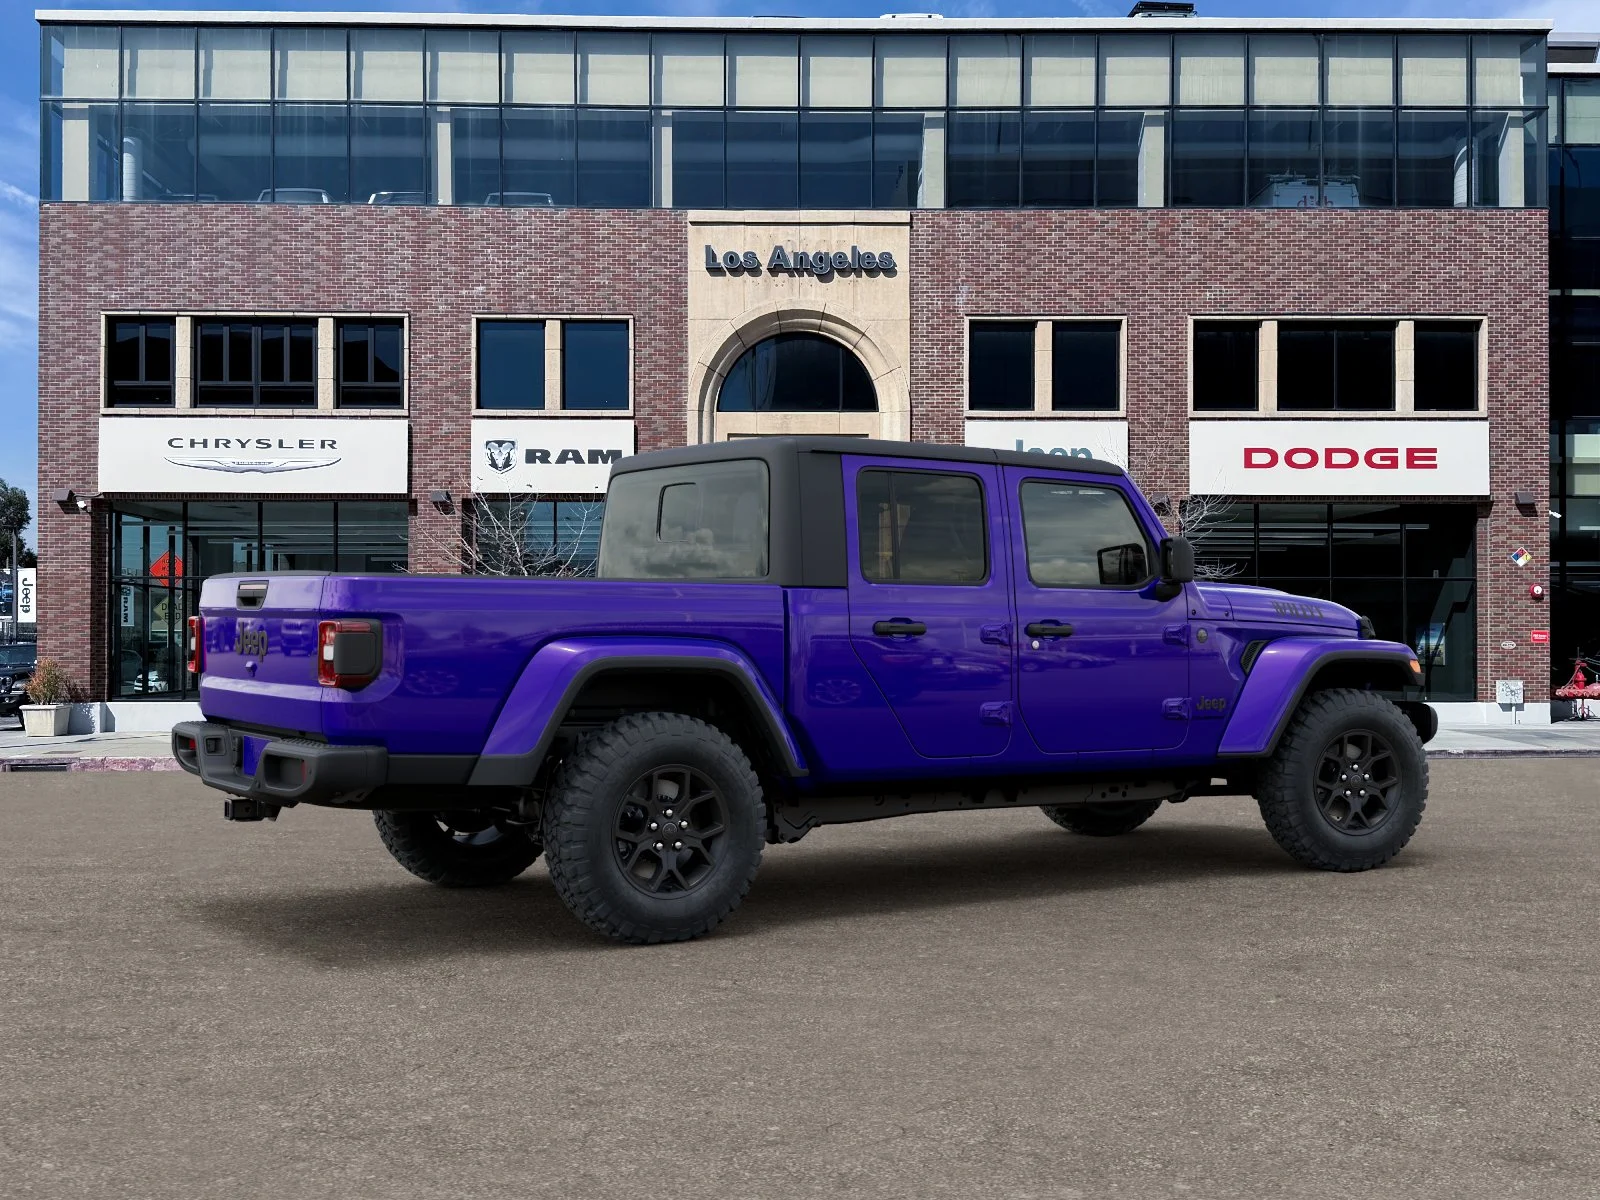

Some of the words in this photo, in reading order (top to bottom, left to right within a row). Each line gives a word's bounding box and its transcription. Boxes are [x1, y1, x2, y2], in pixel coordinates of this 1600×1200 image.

[704, 244, 759, 269] Los
[767, 245, 896, 275] Angeles
[167, 438, 338, 450] CHRYSLER
[525, 448, 623, 465] RAM
[1244, 447, 1438, 469] DODGE
[20, 577, 33, 613] Jeep
[164, 612, 182, 620] ED
[235, 621, 268, 663] Jeep
[1196, 695, 1226, 712] Jeep
